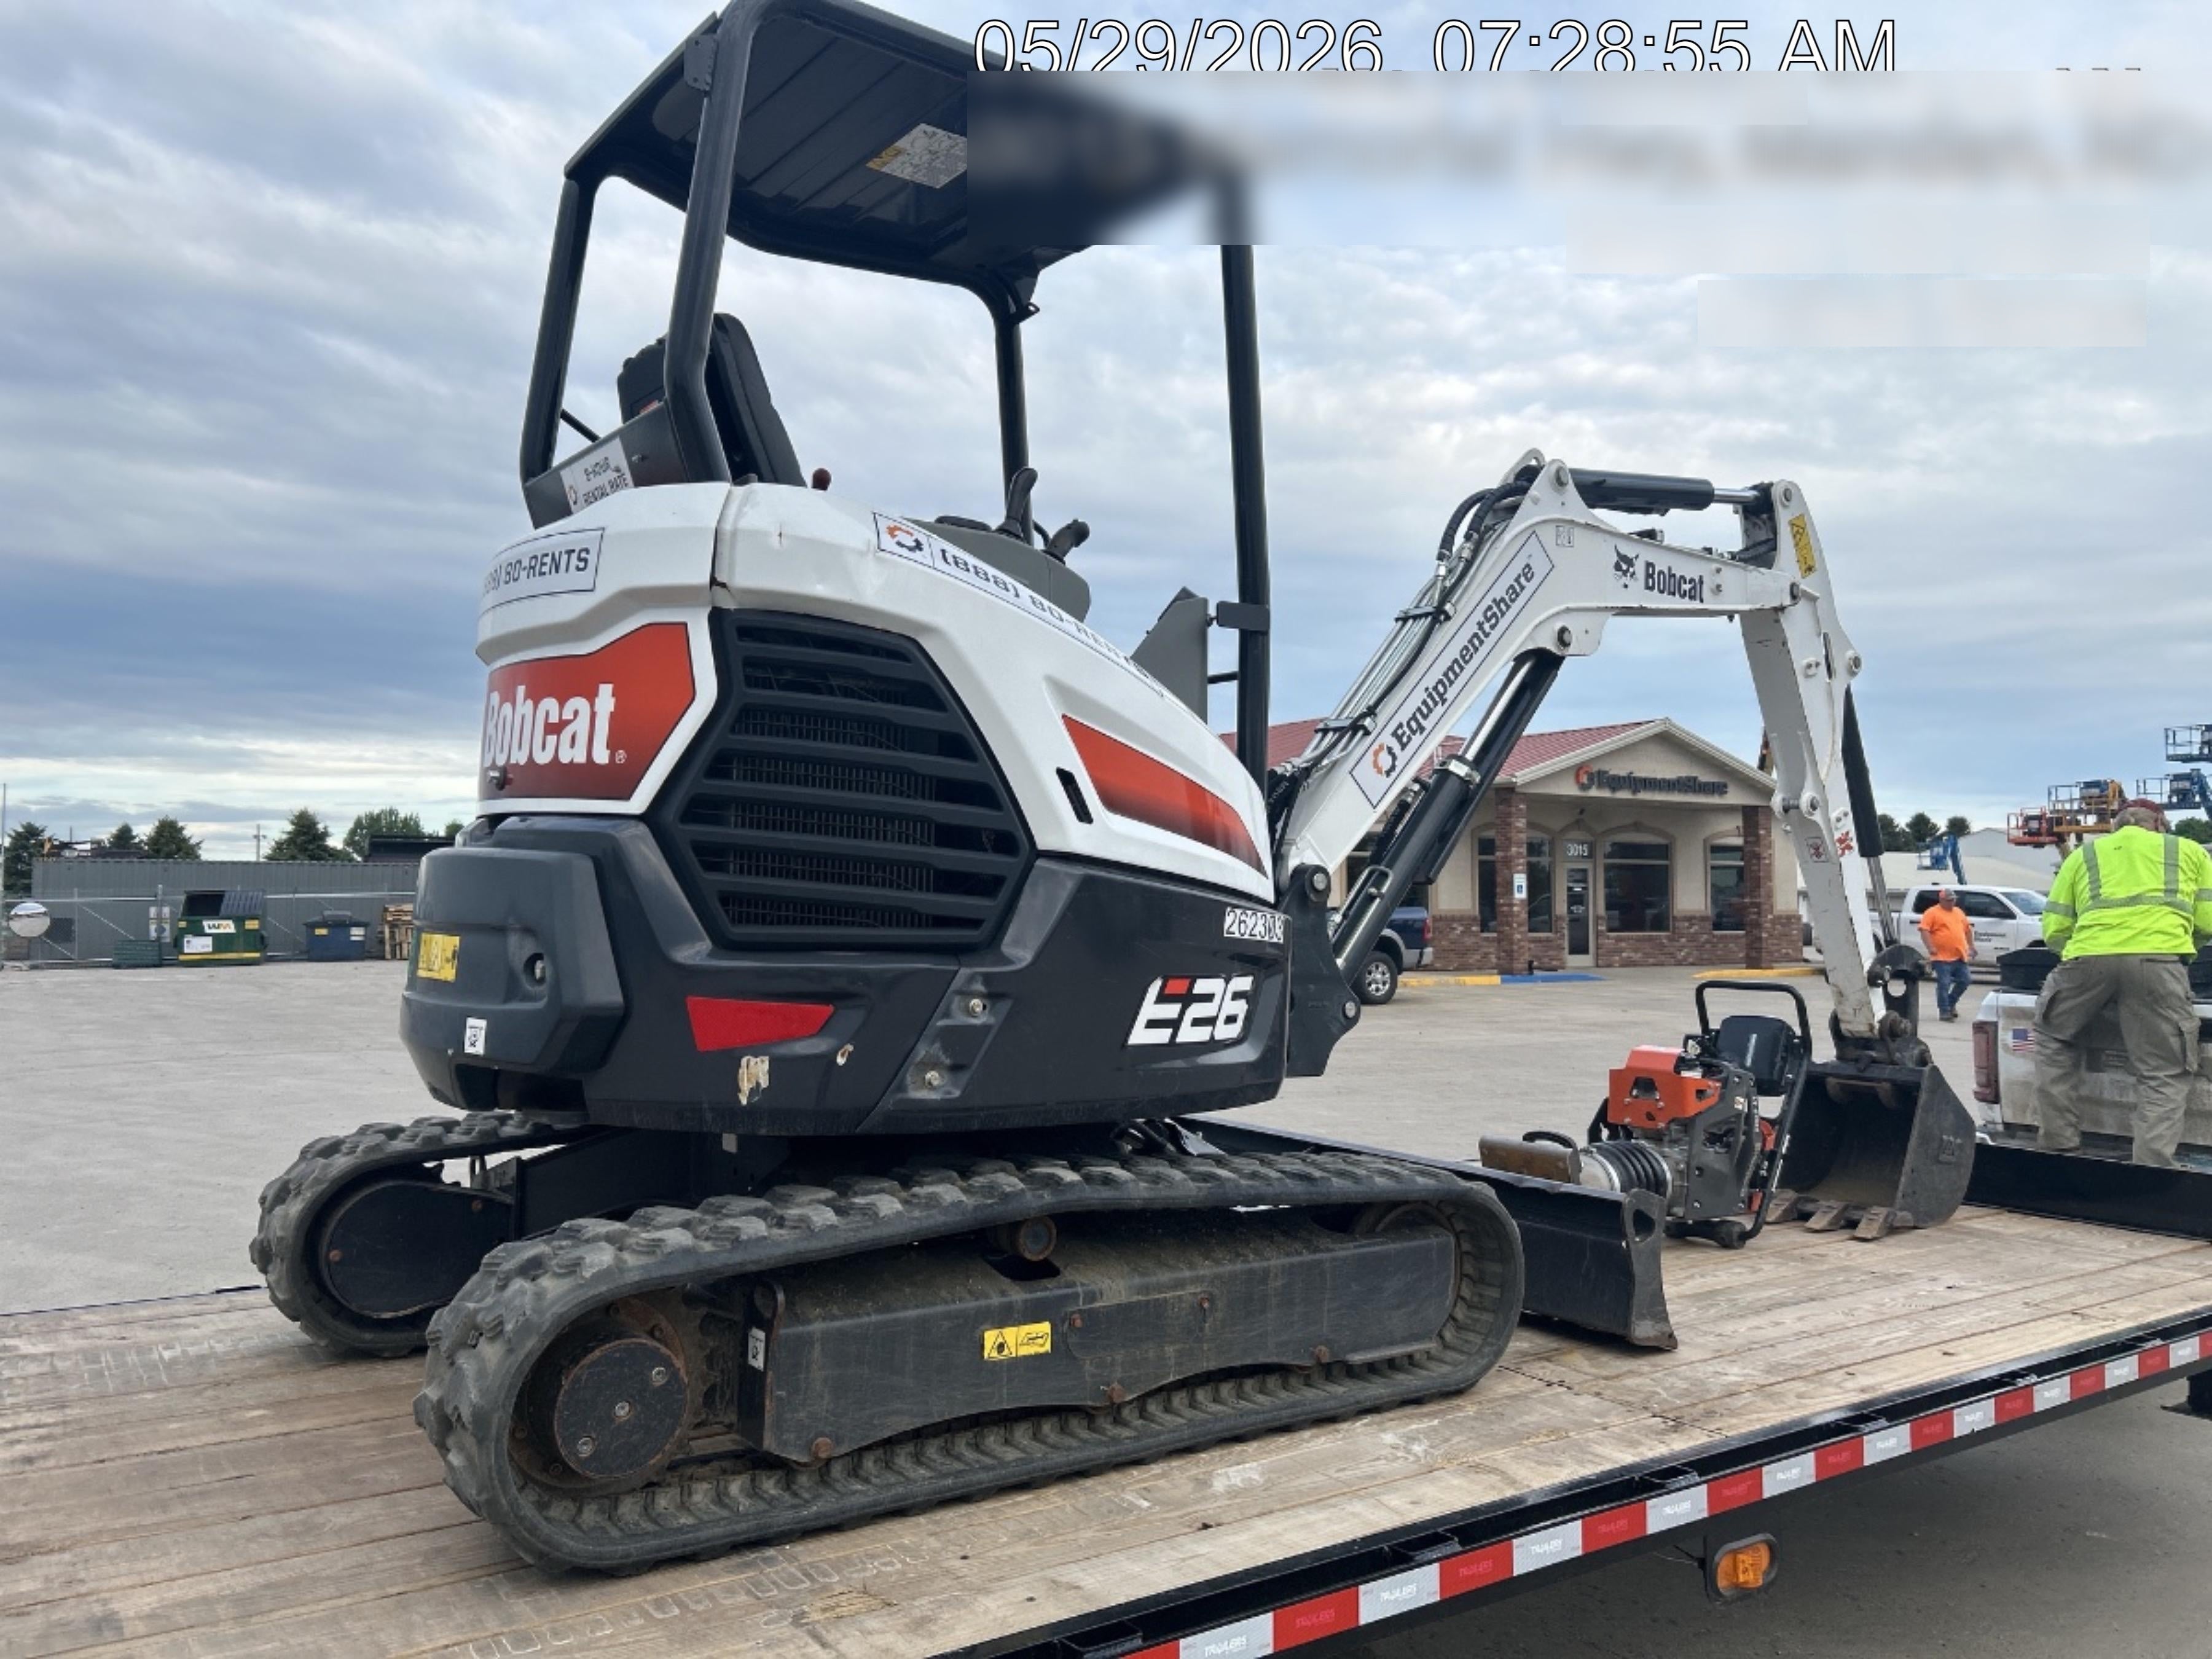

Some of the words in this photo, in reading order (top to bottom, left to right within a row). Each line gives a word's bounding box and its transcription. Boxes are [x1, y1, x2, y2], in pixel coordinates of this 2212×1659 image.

[503, 547, 590, 585] 80-RENTS
[941, 548, 1021, 598] (888)
[1644, 560, 1704, 604] Bobcat
[1390, 562, 1535, 753] EquipmentShare
[483, 683, 616, 767] Bobcat
[1567, 844, 1588, 857] 3015
[1128, 976, 1254, 1044] E26
